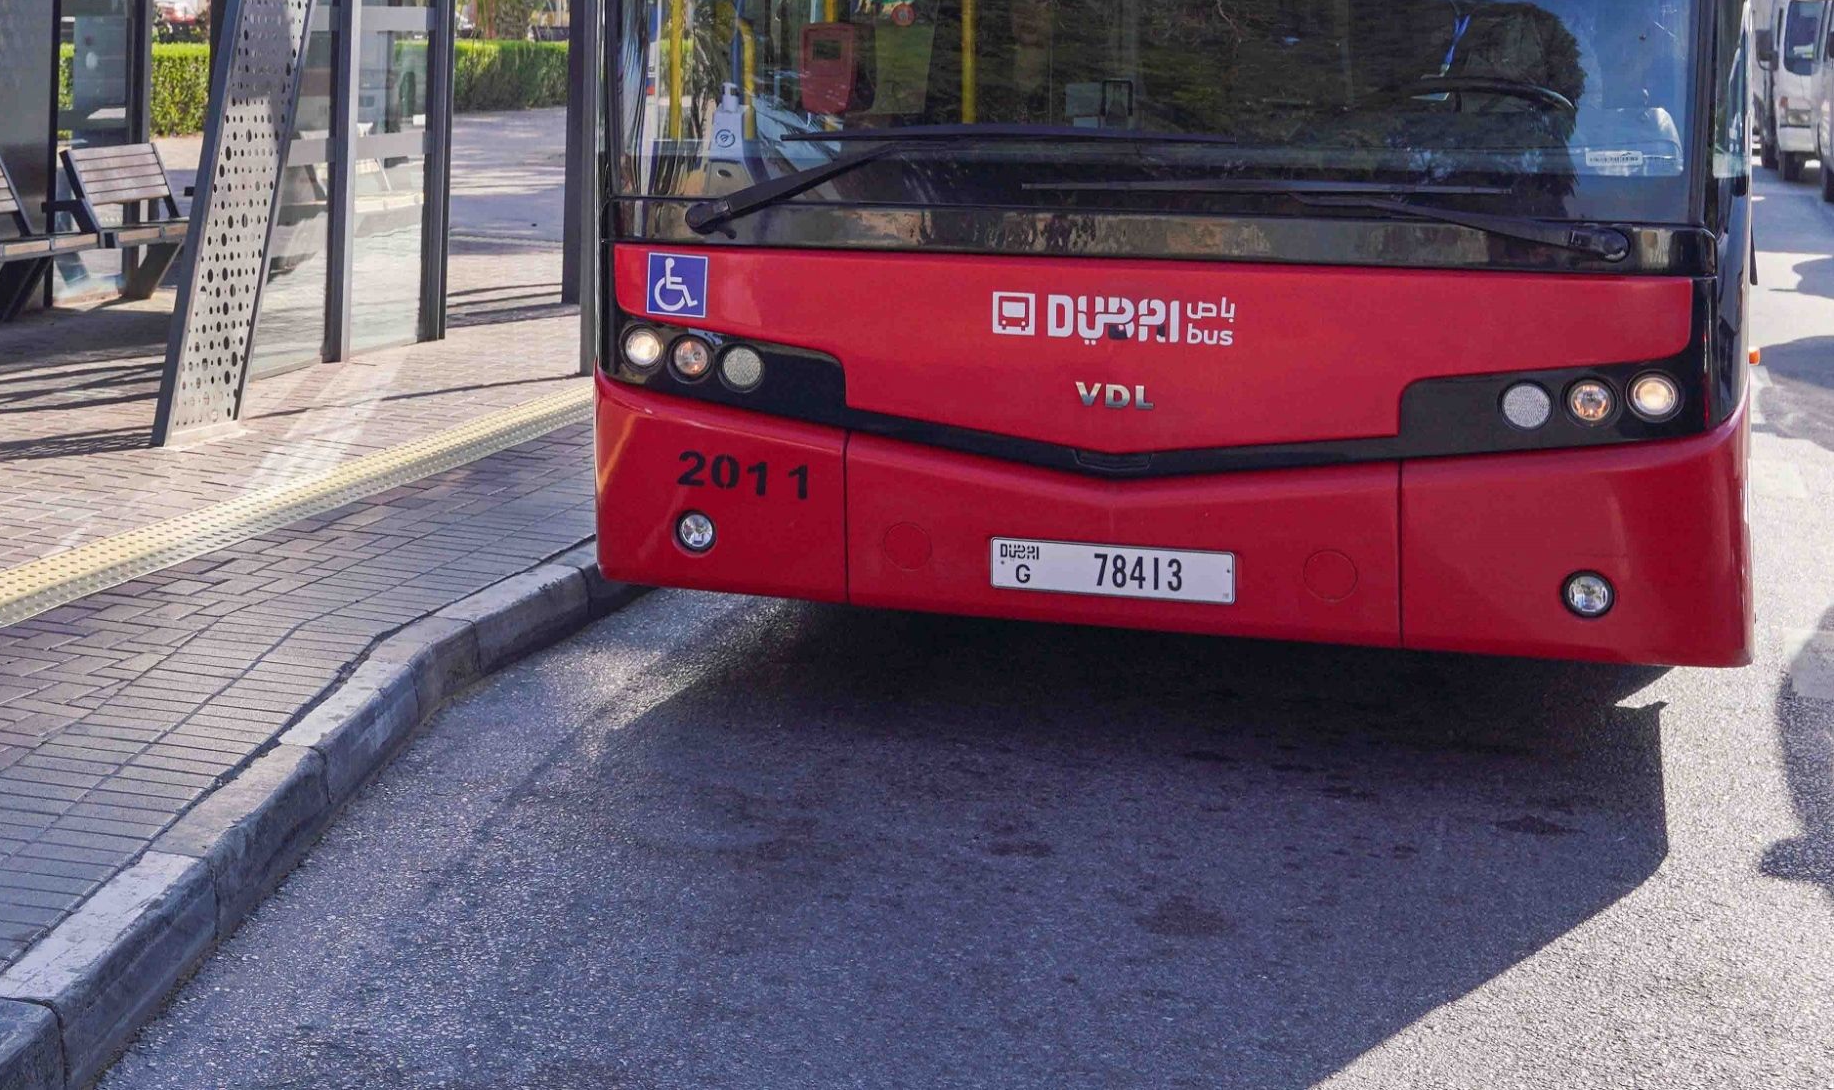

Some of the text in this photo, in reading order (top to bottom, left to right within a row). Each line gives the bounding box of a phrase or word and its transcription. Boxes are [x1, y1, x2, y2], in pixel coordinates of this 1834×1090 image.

[1186, 296, 1236, 323] باص
[1186, 323, 1234, 346] bus
[1075, 380, 1155, 409] VDL
[676, 450, 809, 501] 2011
[1015, 563, 1031, 584] G
[1093, 552, 1183, 592] 78413
